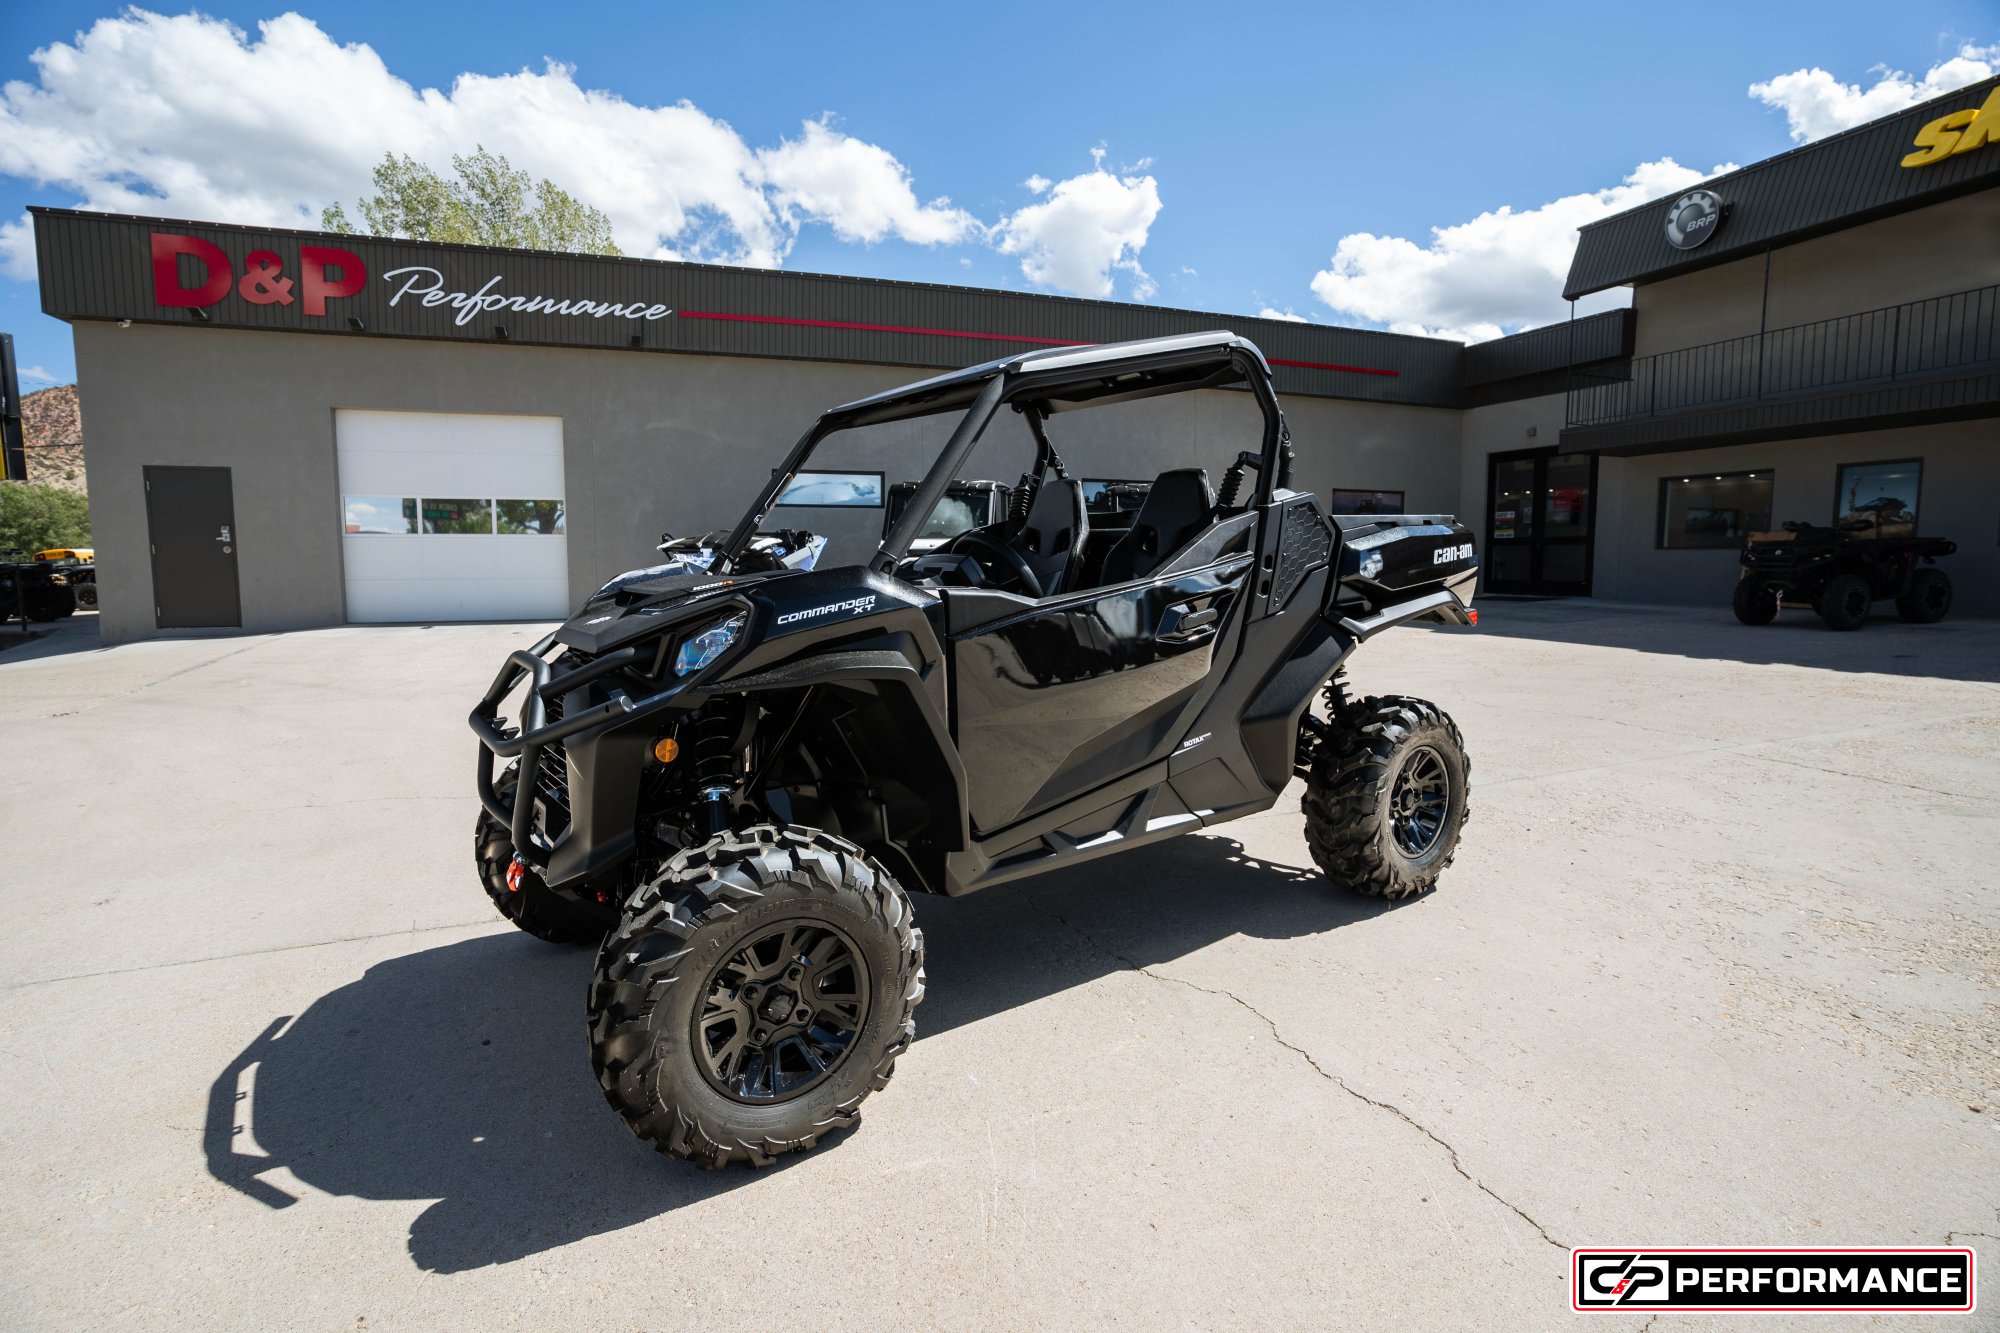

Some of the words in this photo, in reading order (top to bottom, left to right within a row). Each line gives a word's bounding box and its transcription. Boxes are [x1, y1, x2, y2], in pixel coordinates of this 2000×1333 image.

[1686, 213, 1716, 232] BRP
[150, 232, 367, 318] D&P
[383, 266, 672, 326] Performance
[1433, 543, 1473, 565] can-am
[777, 595, 876, 625] COMMANDER
[852, 604, 875, 615] XT
[1183, 736, 1205, 748] ROTAX
